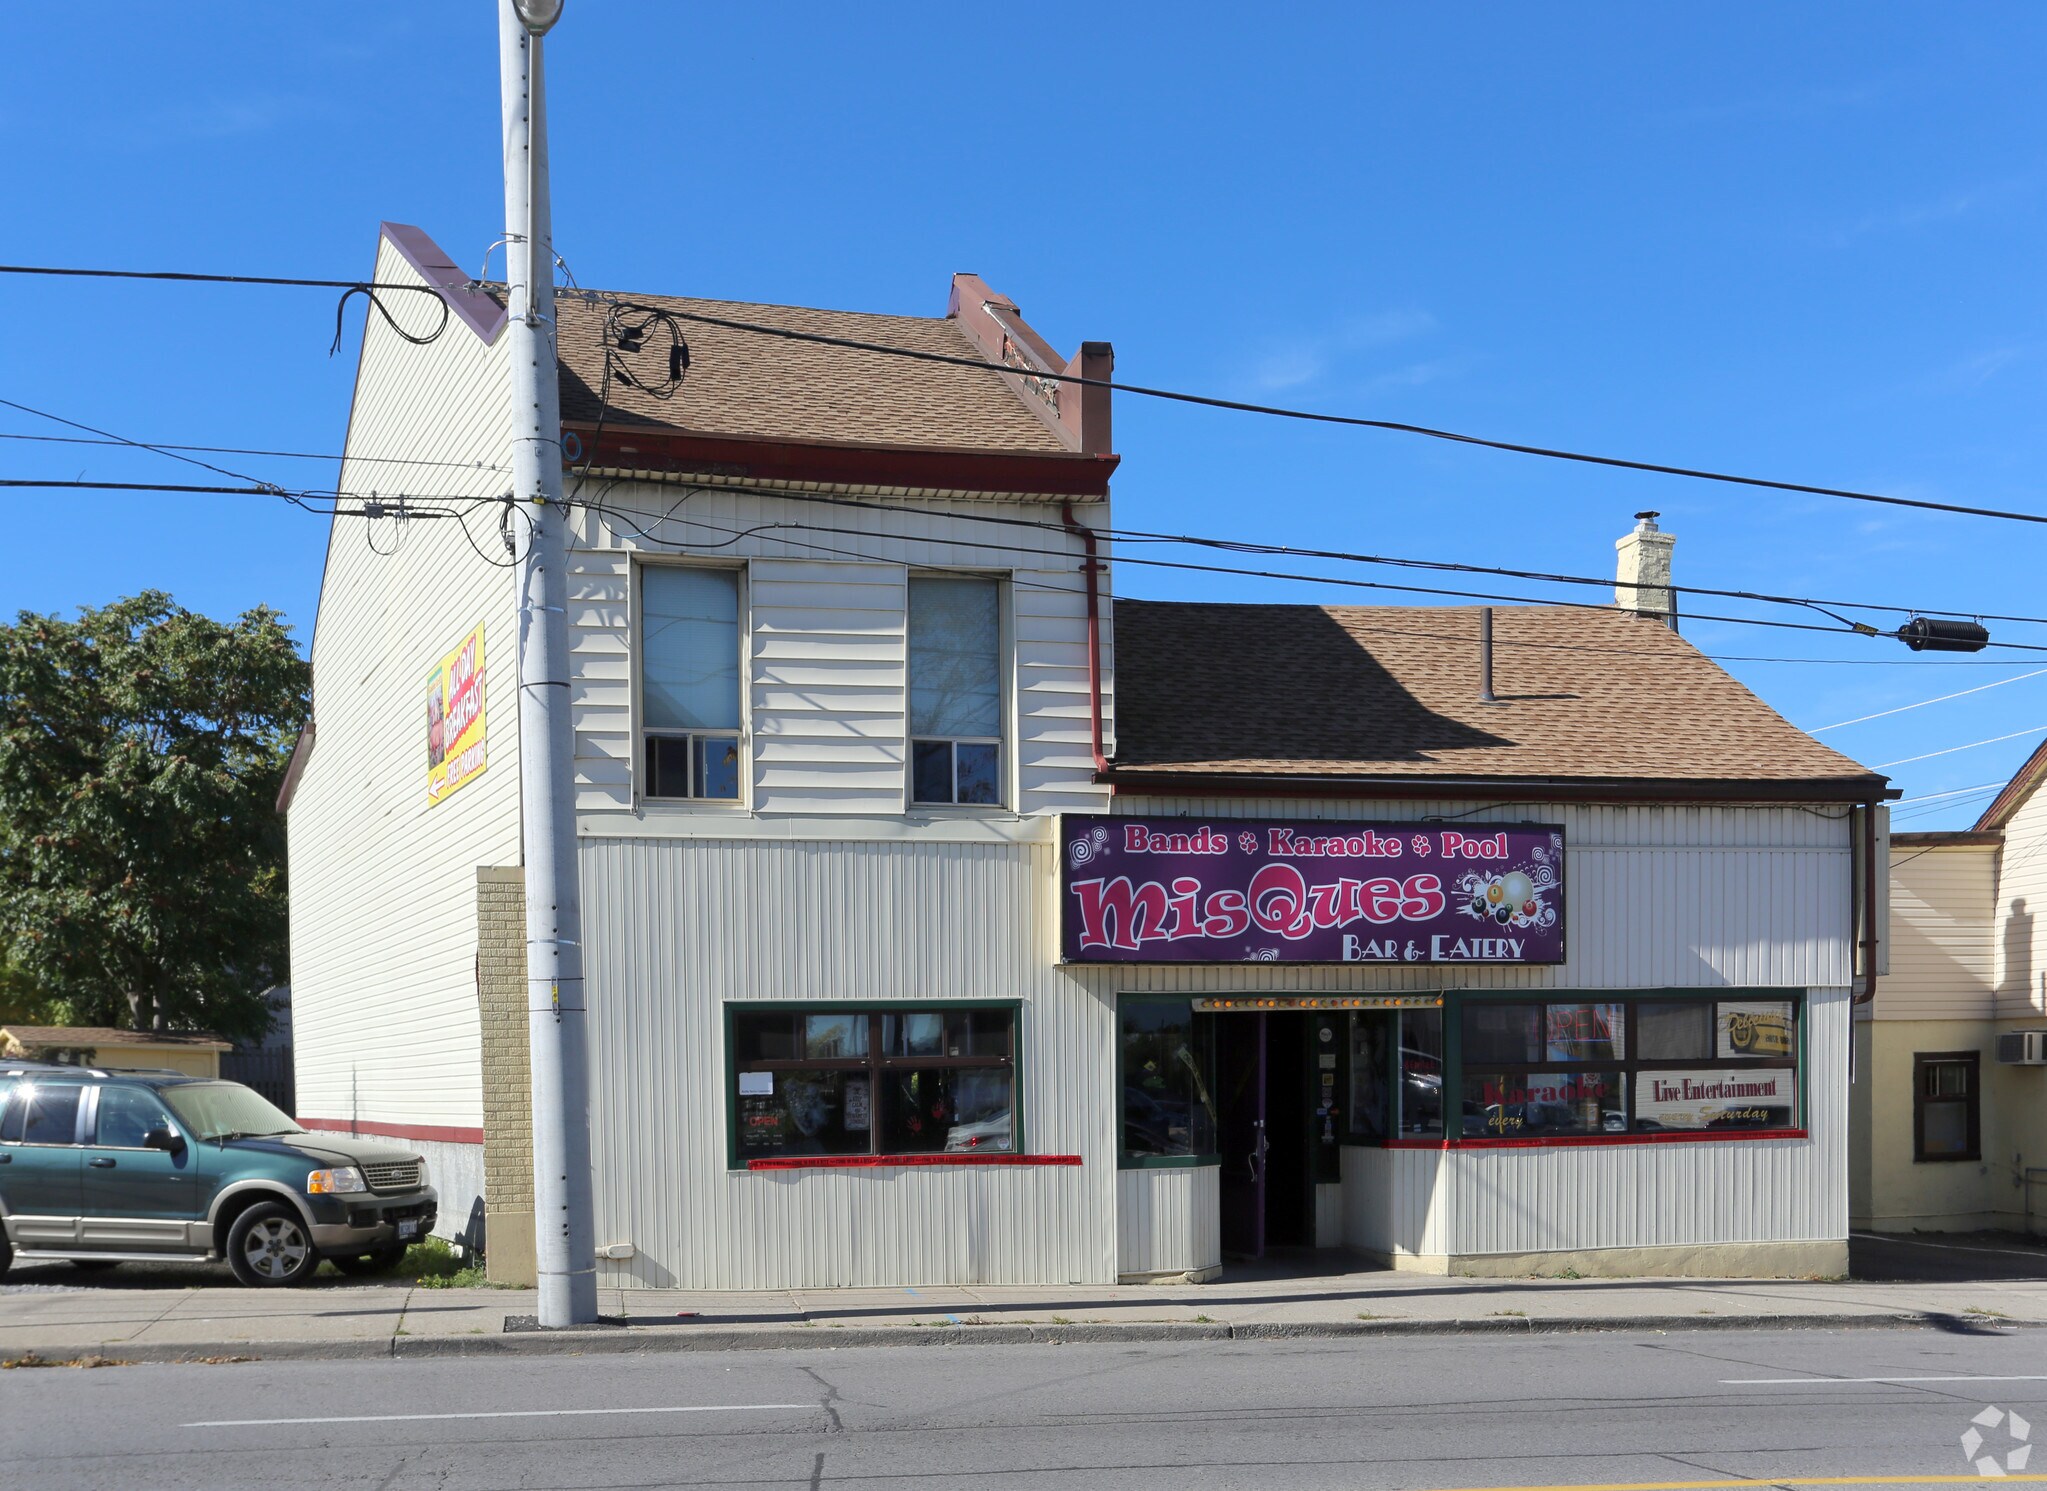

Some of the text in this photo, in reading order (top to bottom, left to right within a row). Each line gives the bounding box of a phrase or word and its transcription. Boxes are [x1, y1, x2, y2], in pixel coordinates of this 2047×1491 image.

[448, 635, 477, 704] ALL DAY
[445, 668, 484, 754] BREAKFAST
[1124, 824, 1510, 860] Bands Karaoke Pool
[1404, 940, 1426, 961] &
[1483, 1075, 1611, 1106] Karaoke
[1653, 1076, 1777, 1102] Live Entertainment
[749, 1115, 779, 1127] OPEN
[1488, 1115, 1523, 1130] every
[1697, 1105, 1770, 1122] Saturday
